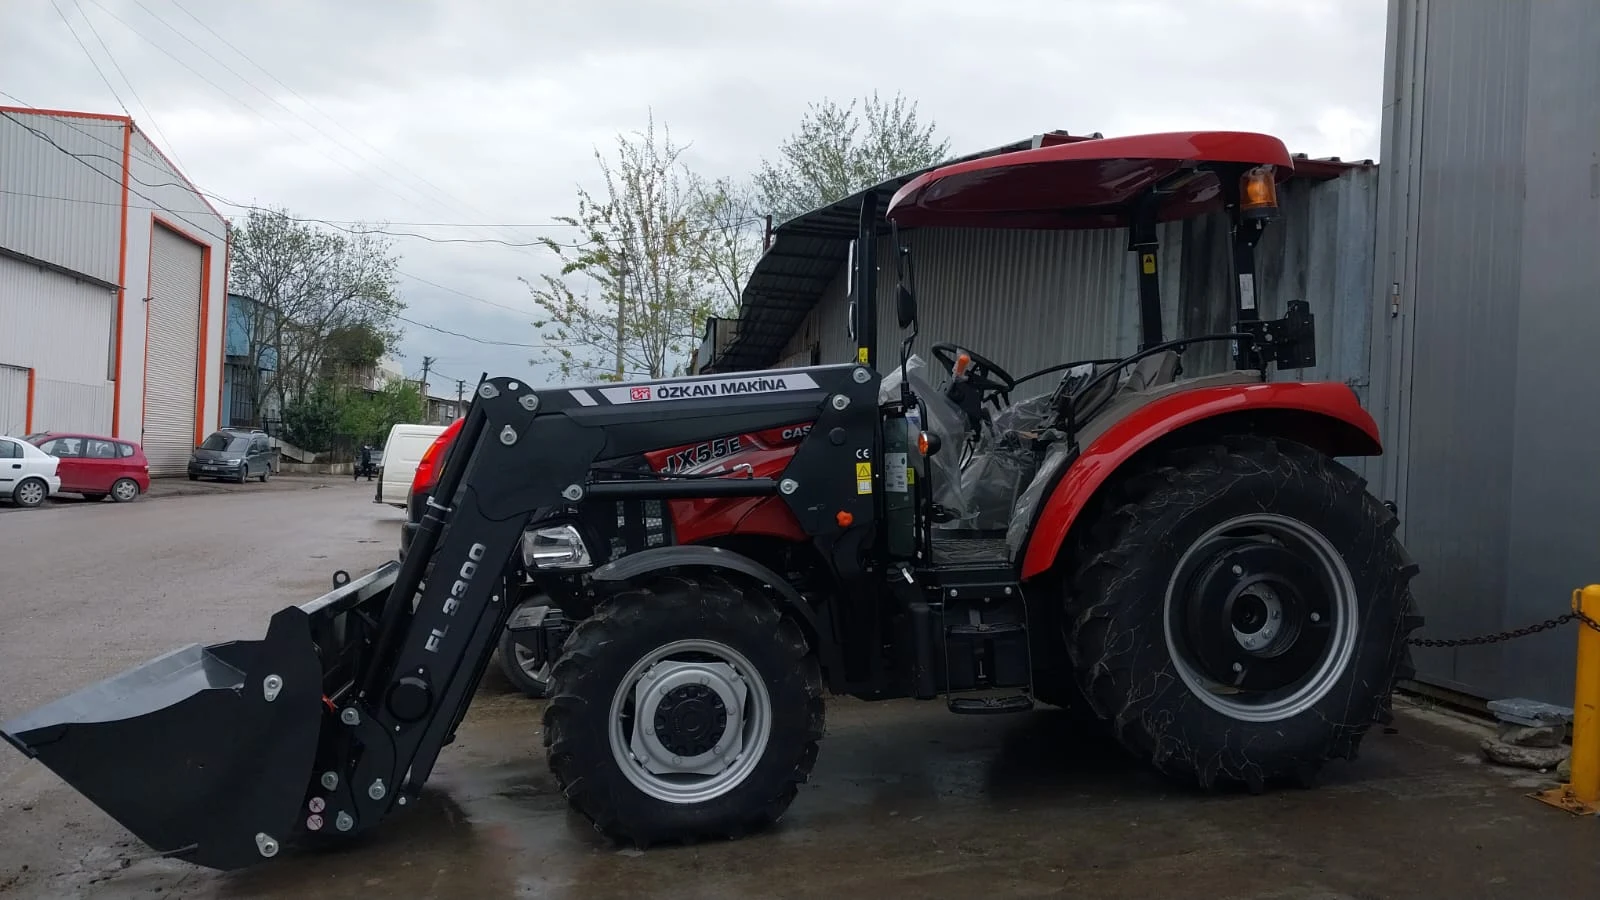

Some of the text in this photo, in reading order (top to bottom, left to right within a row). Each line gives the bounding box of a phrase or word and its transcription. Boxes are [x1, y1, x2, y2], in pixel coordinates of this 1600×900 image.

[657, 383, 717, 400] ÖZKAN
[721, 377, 787, 395] MAKİNA
[424, 543, 487, 653] FL 3300
